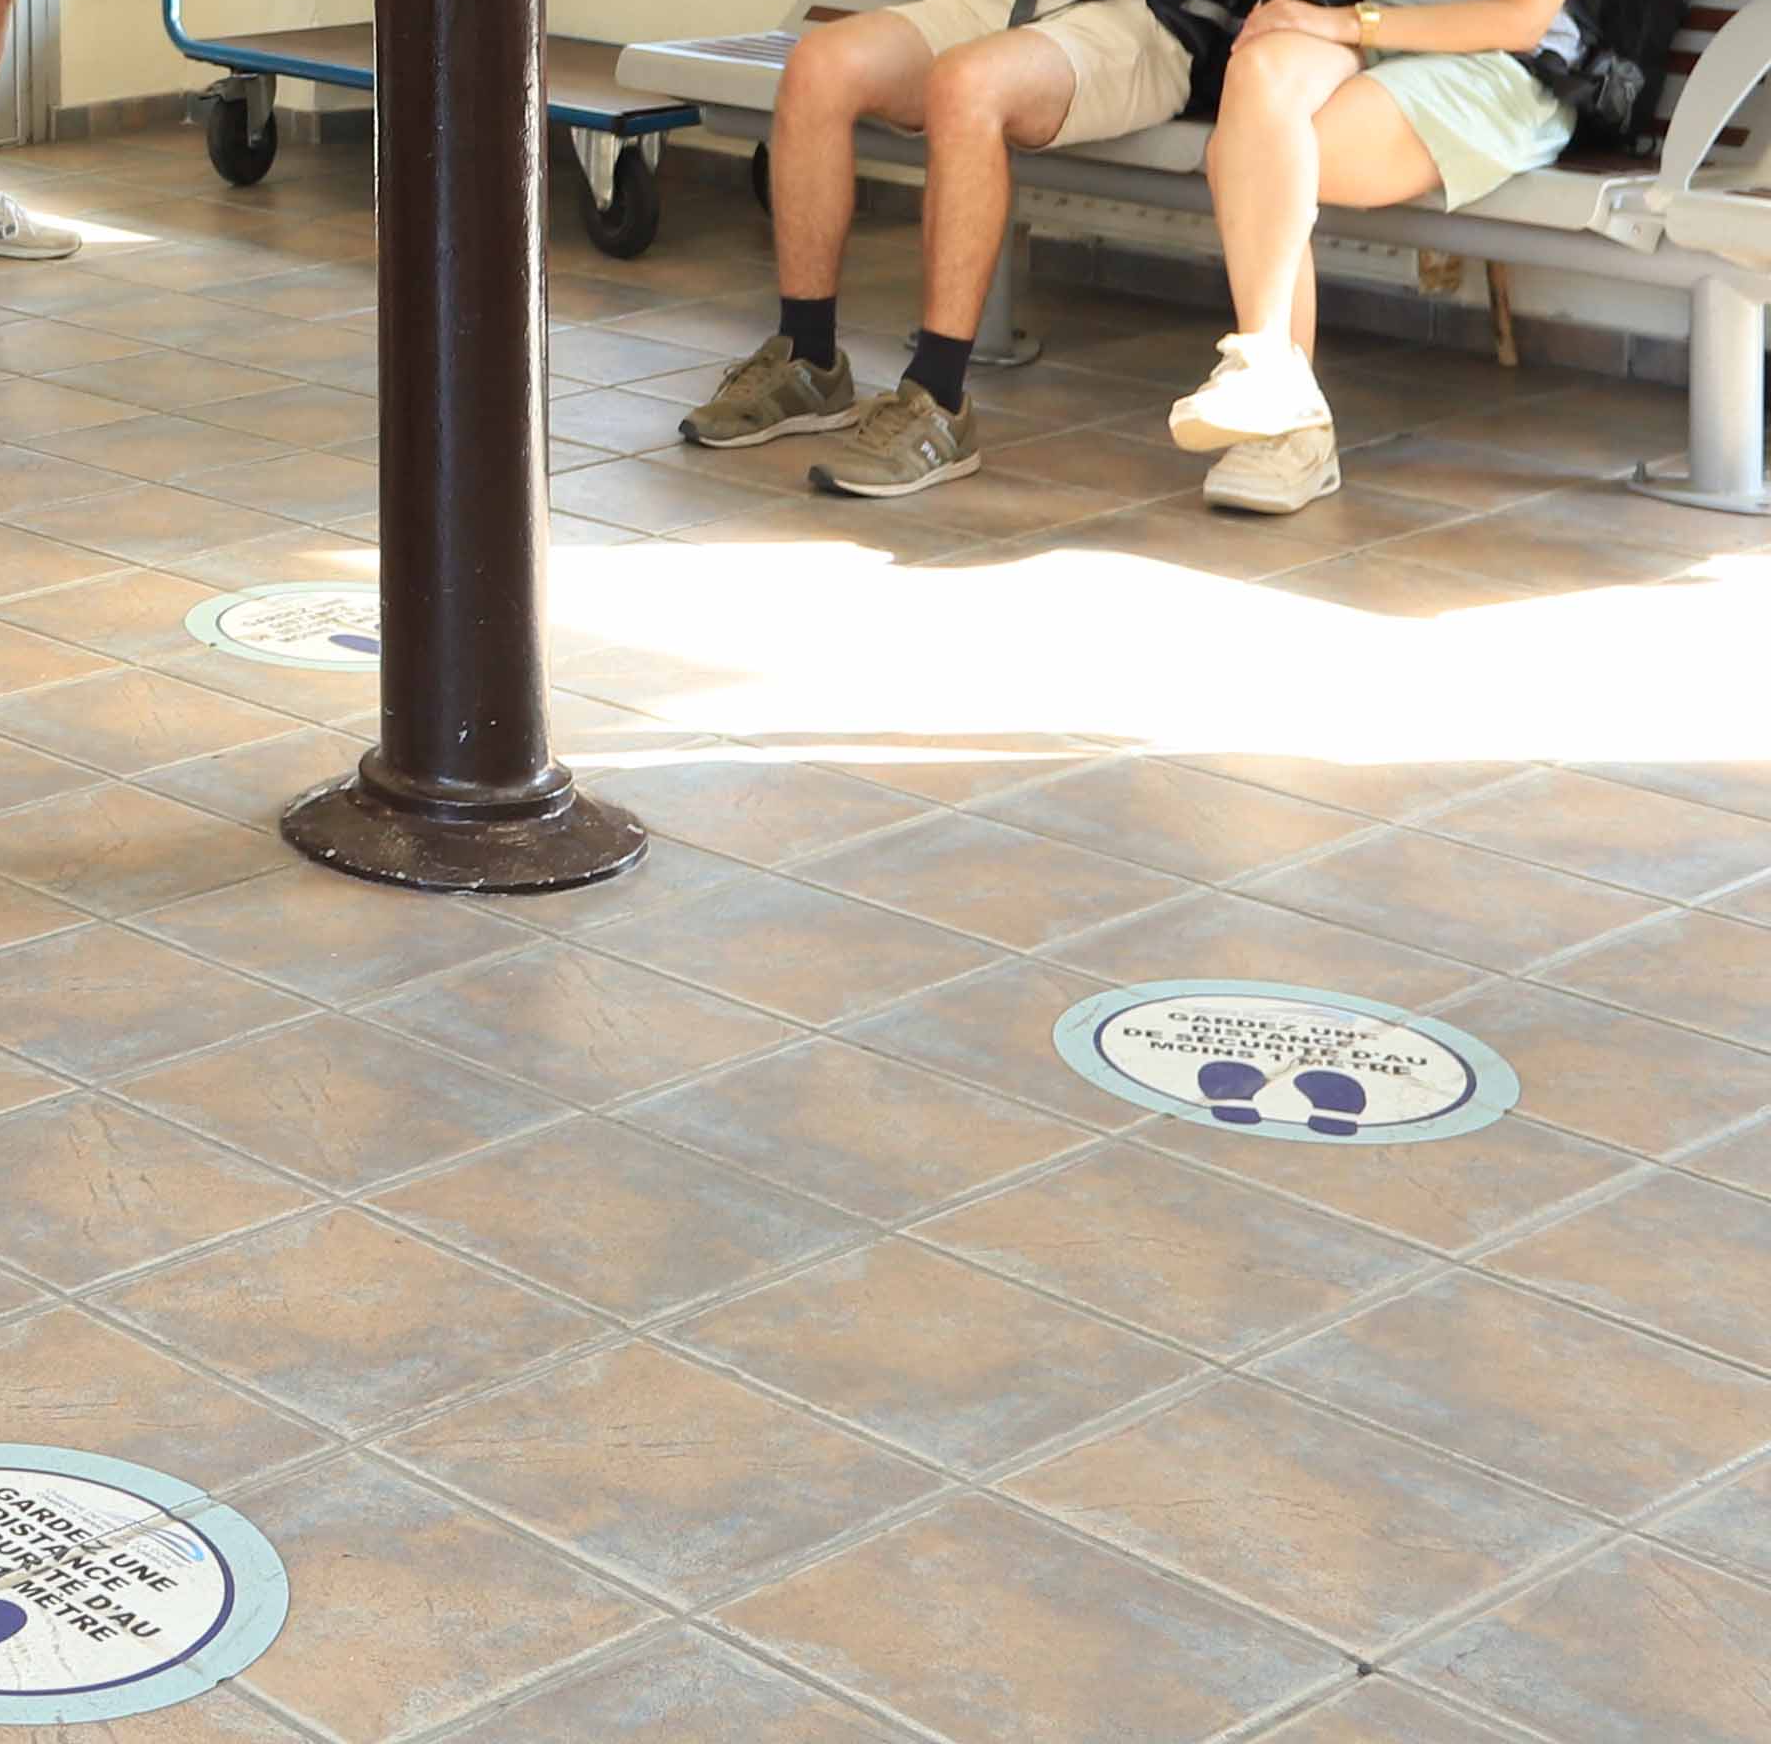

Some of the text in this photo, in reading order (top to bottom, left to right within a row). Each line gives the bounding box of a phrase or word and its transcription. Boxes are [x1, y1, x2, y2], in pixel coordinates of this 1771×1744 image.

[1167, 1012, 1379, 1041] GARDEZ UNE
[1191, 1024, 1357, 1049] DISTANCE
[1122, 1026, 1428, 1067] DE D'AU
[1149, 1041, 1256, 1060] MOINS
[108, 1553, 179, 1594] UNE
[82, 1593, 162, 1639] D'AU
